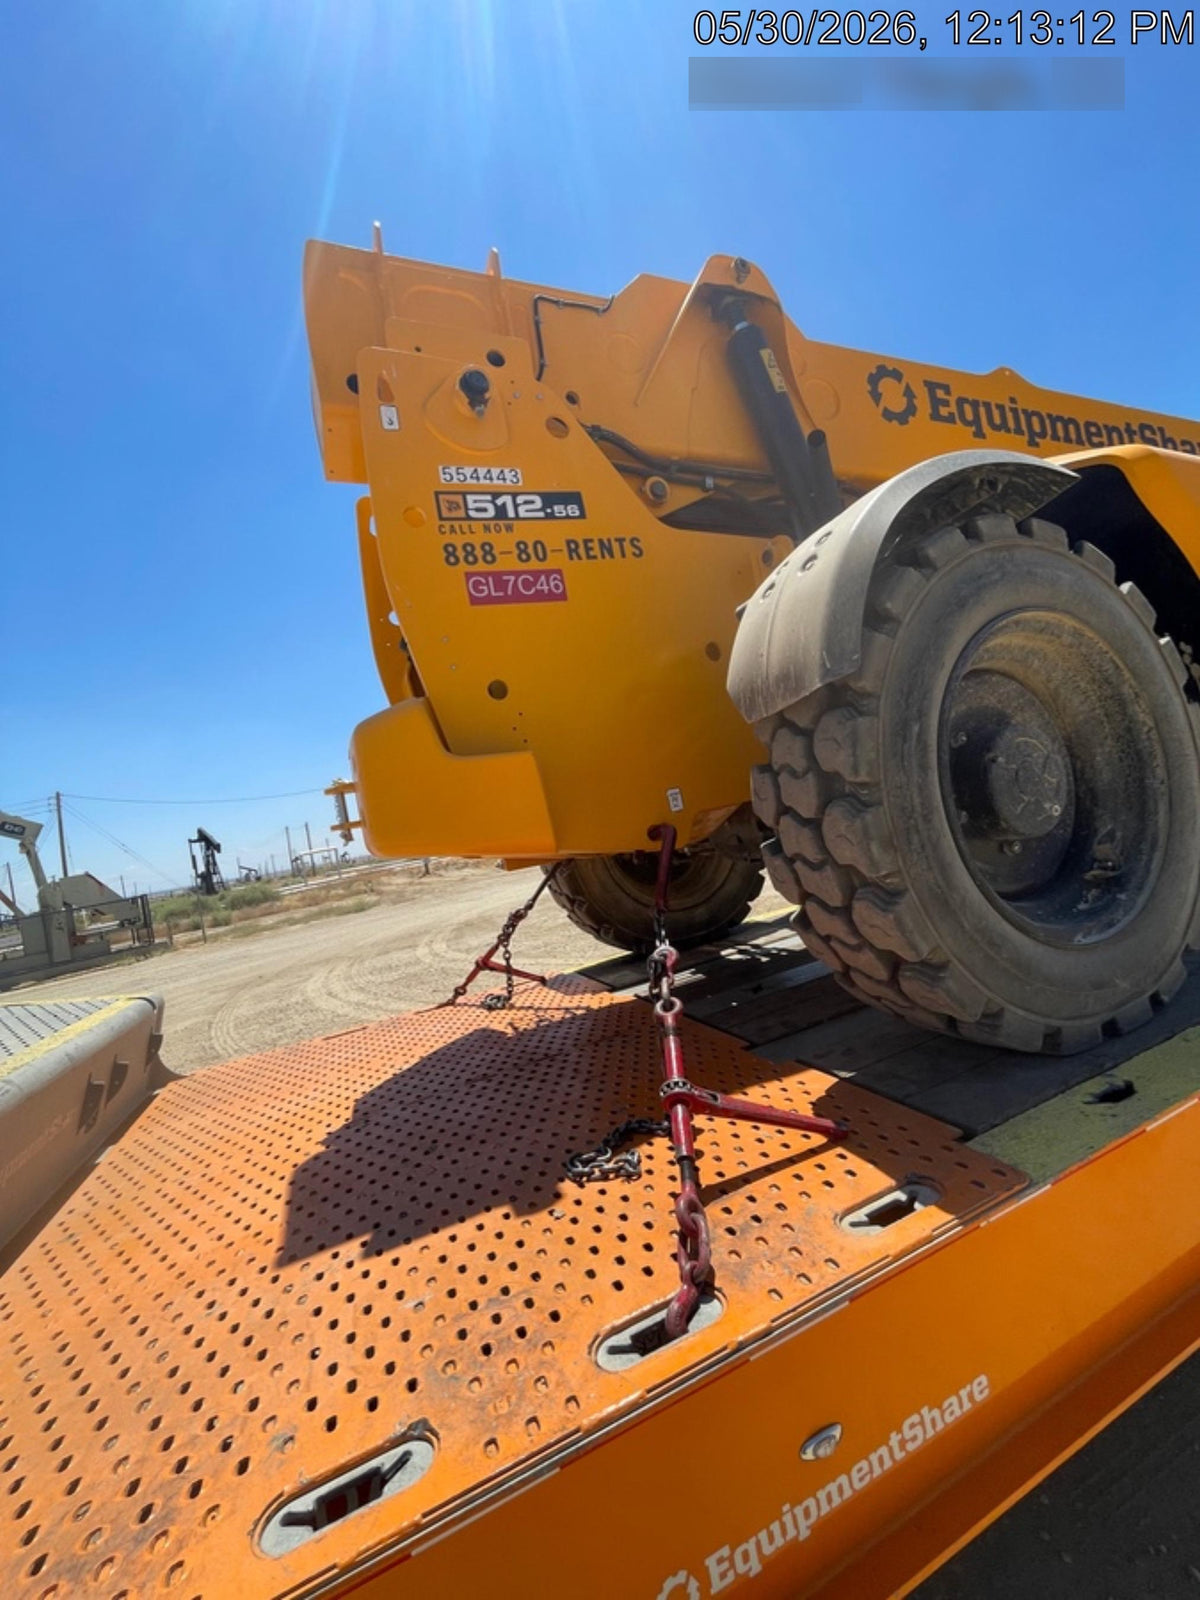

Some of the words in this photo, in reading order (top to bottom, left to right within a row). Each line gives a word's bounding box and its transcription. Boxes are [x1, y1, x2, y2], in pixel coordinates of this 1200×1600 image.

[923, 380, 1200, 455] EquipmentSha
[441, 466, 520, 484] 554443
[438, 524, 475, 535] CALL
[483, 523, 514, 533] NOW
[443, 537, 644, 566] 888-80-RENTS
[468, 575, 564, 597] GL7C46
[705, 1373, 990, 1595] EquipmentShare
